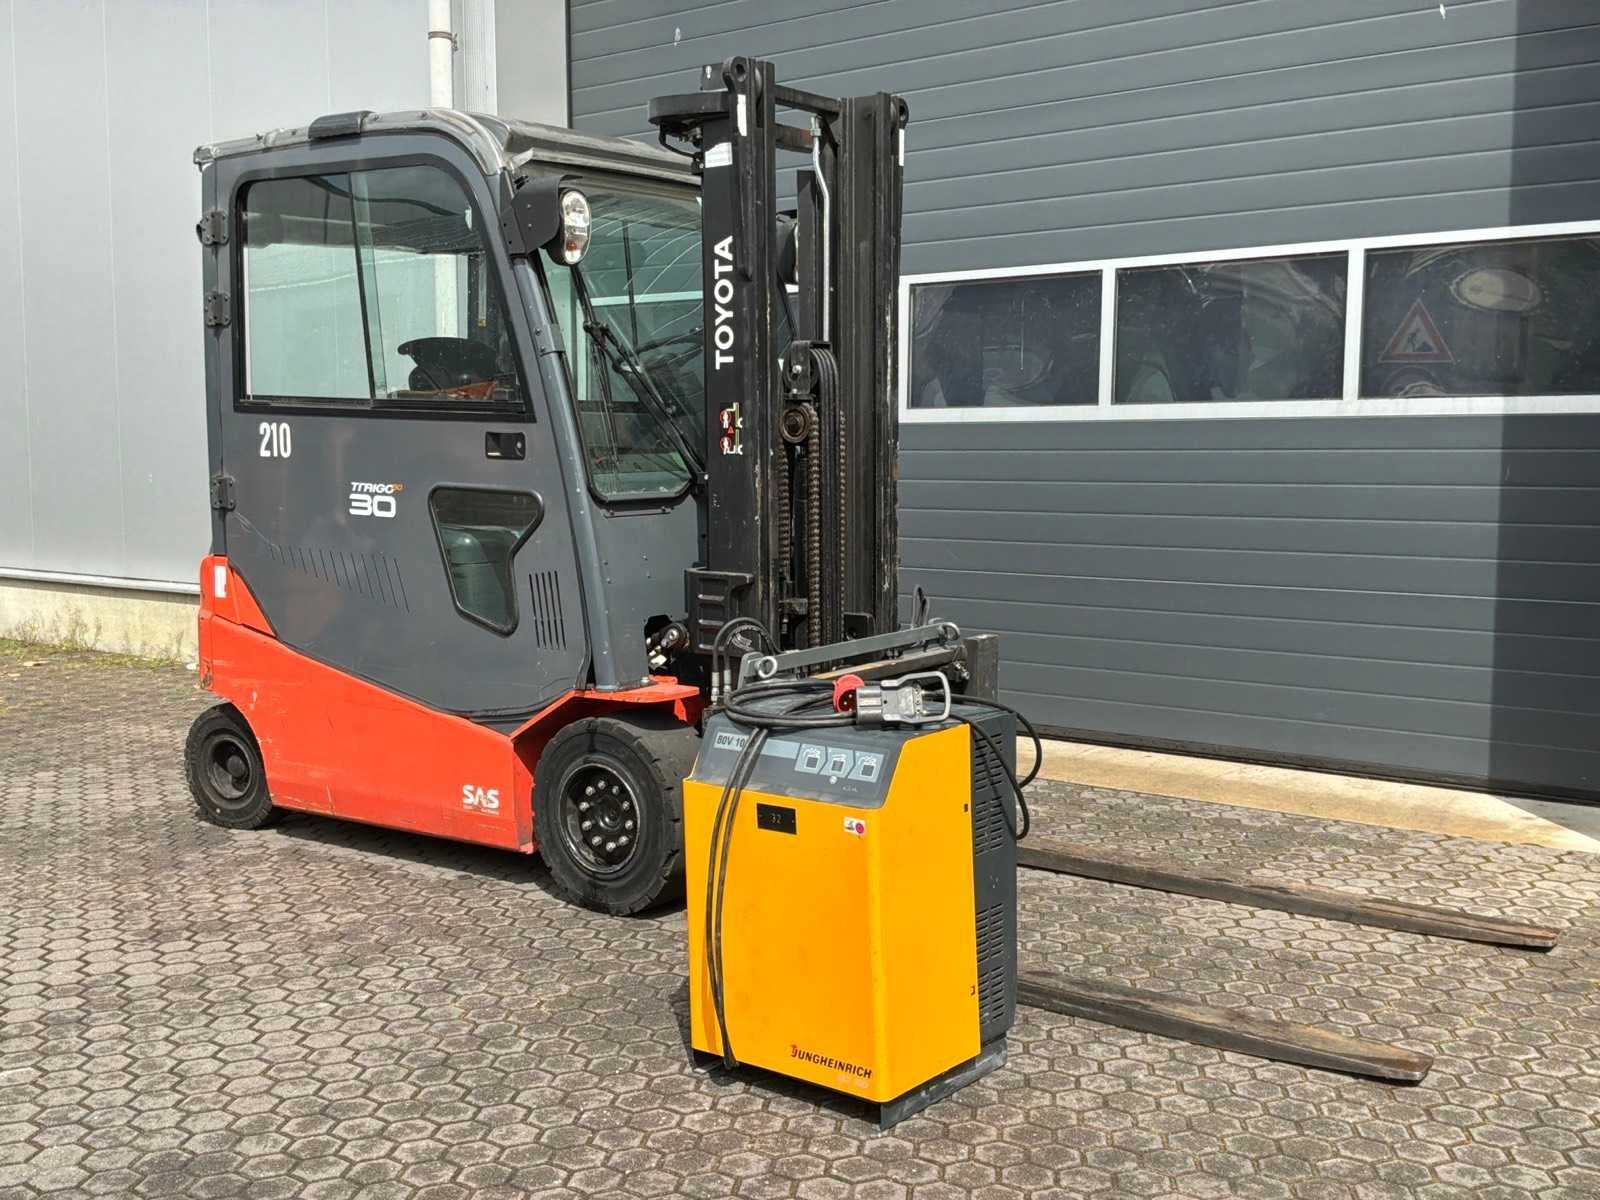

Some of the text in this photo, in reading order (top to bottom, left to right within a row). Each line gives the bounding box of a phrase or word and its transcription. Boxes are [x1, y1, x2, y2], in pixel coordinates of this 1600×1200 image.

[714, 235, 734, 371] TOYOTA
[259, 422, 292, 458] 210
[349, 493, 397, 518] 30
[463, 784, 500, 809] SAS
[790, 1043, 873, 1079] JUNGHEINRICH
